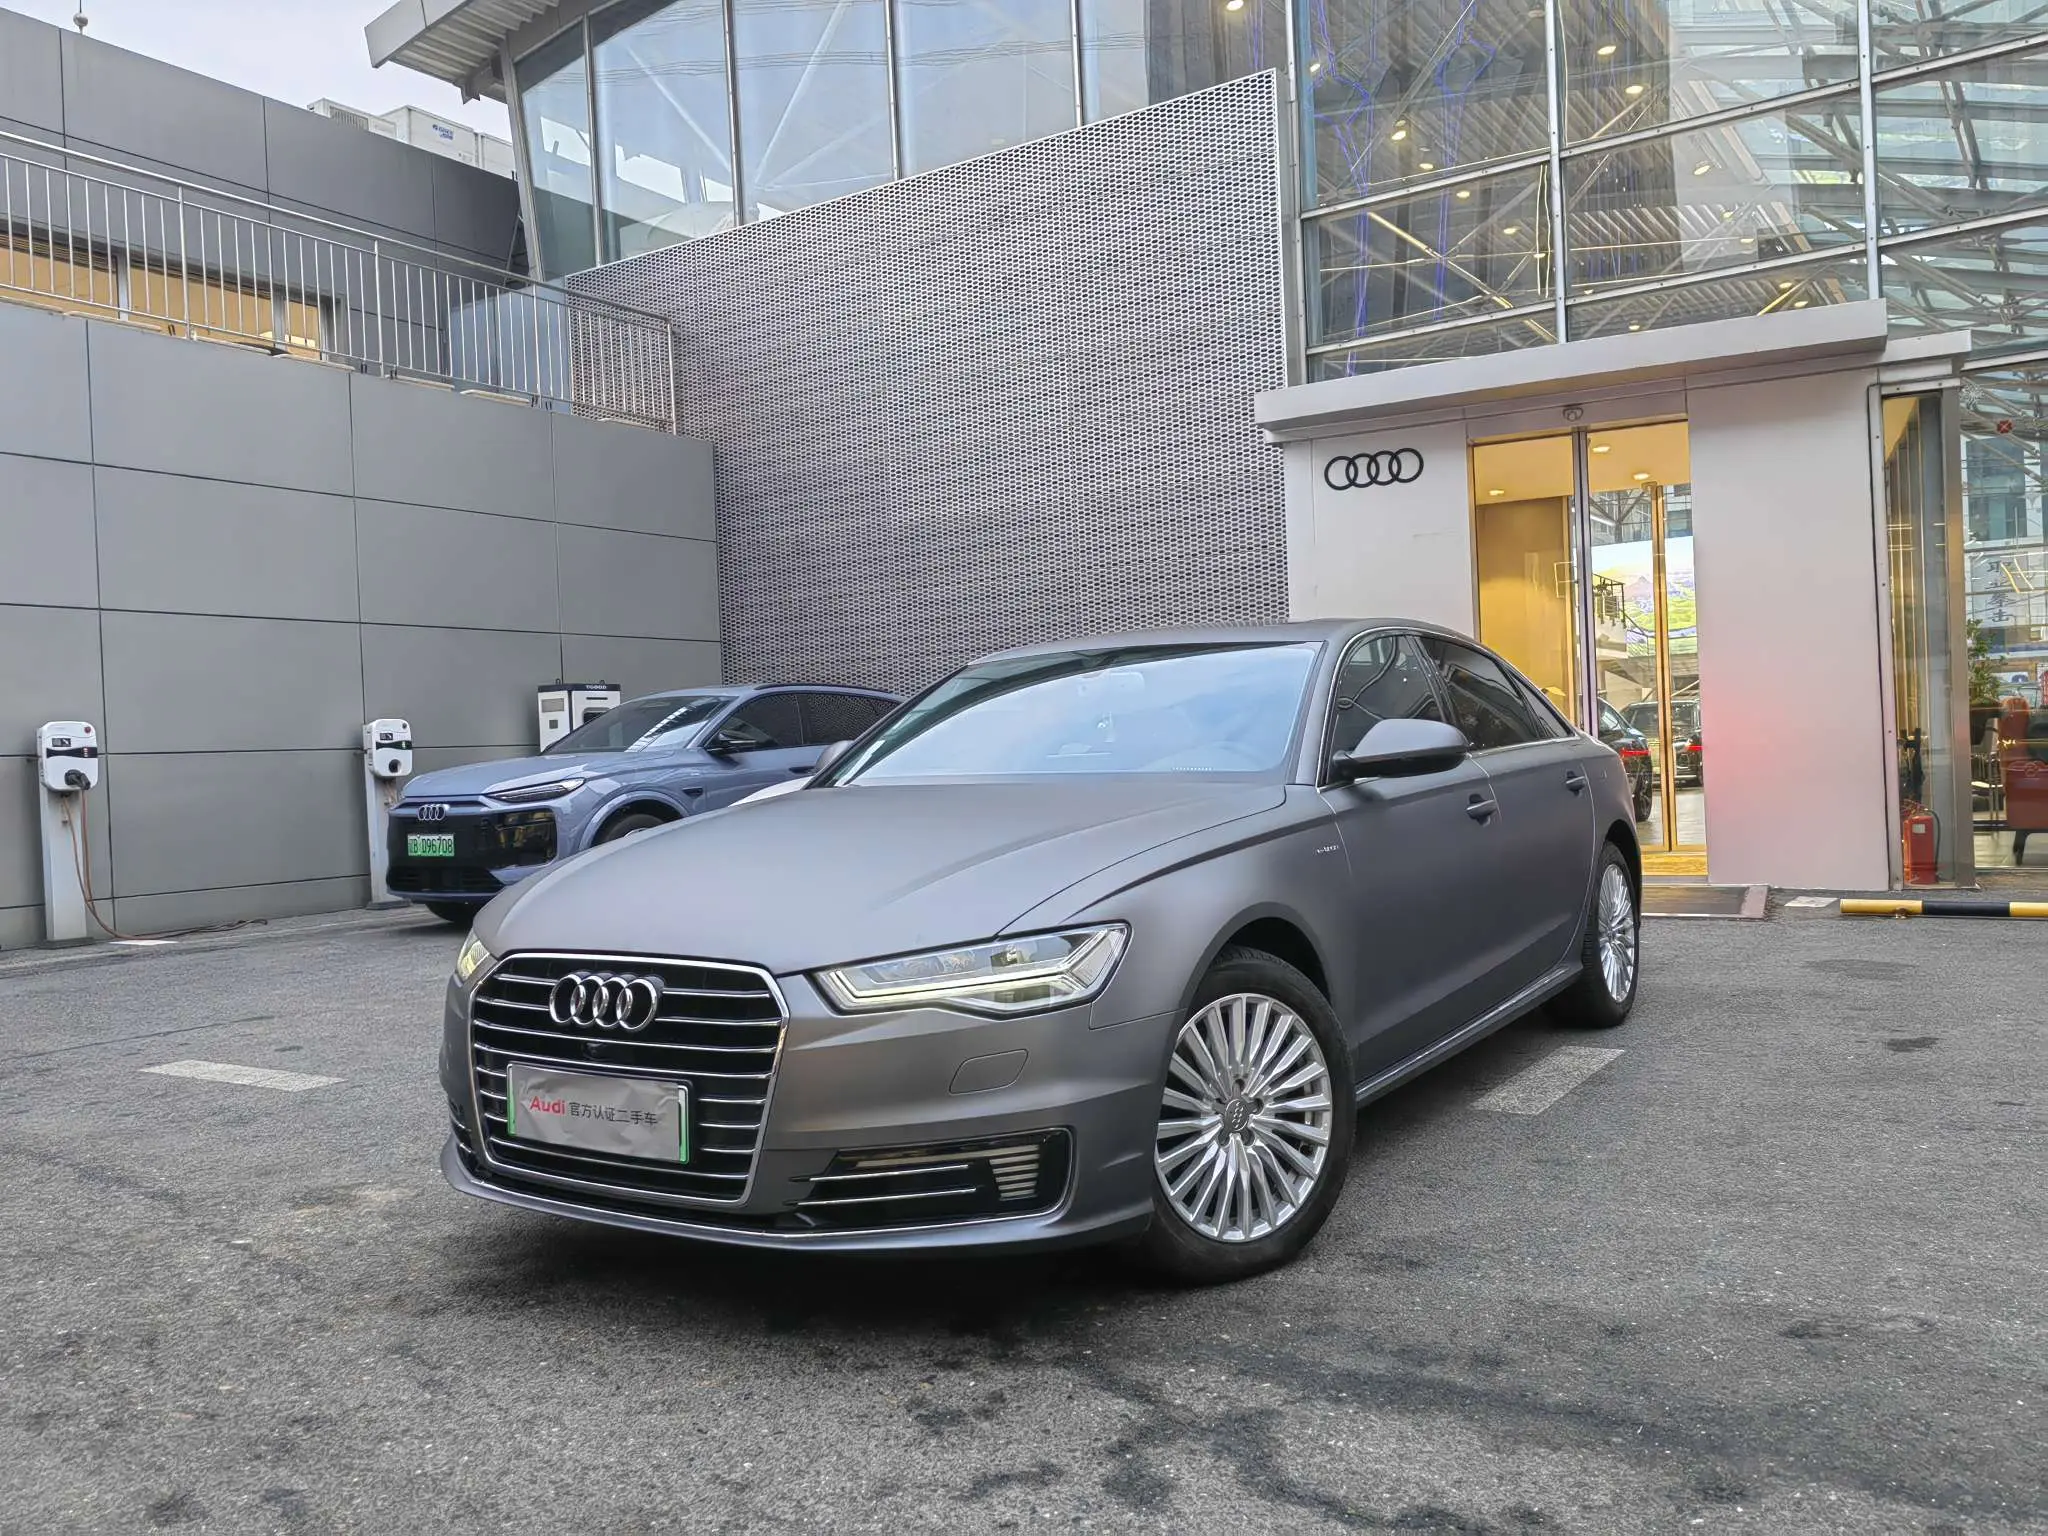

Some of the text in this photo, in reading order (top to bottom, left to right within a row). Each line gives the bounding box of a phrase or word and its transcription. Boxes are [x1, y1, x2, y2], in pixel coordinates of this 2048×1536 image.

[530, 1096, 658, 1125] Audi 官方认证二手车
